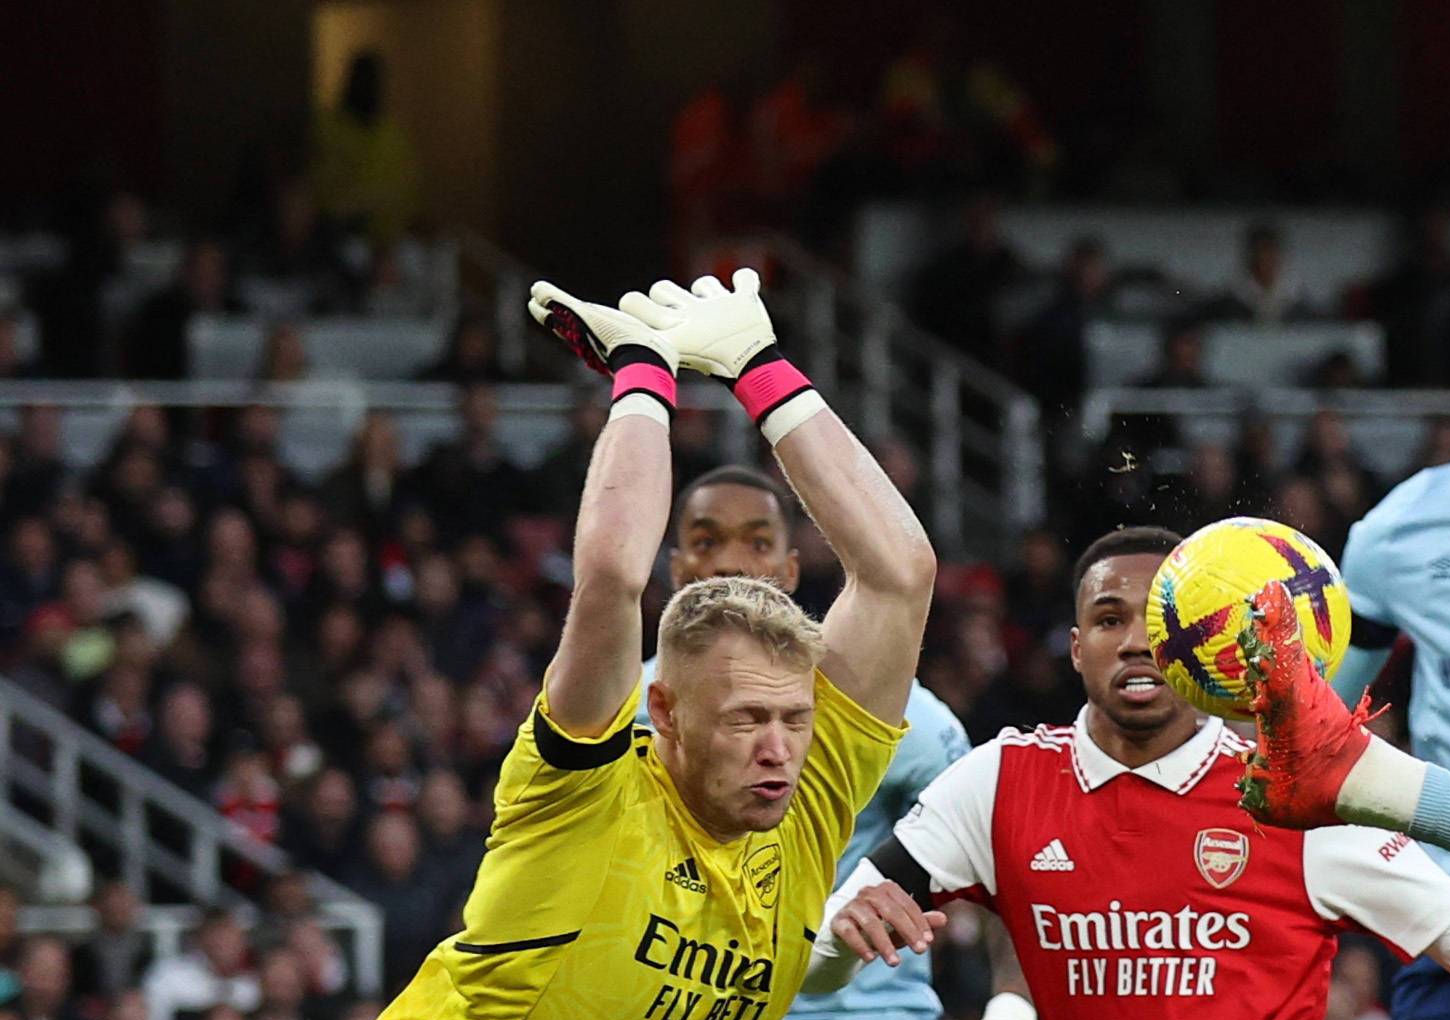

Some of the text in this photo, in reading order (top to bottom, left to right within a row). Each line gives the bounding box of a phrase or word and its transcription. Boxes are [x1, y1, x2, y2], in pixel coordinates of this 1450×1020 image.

[1030, 859, 1075, 871] adidas
[664, 870, 707, 894] adidas
[1031, 900, 1250, 950] Emirates
[1067, 957, 1217, 996] FLY BETTER
